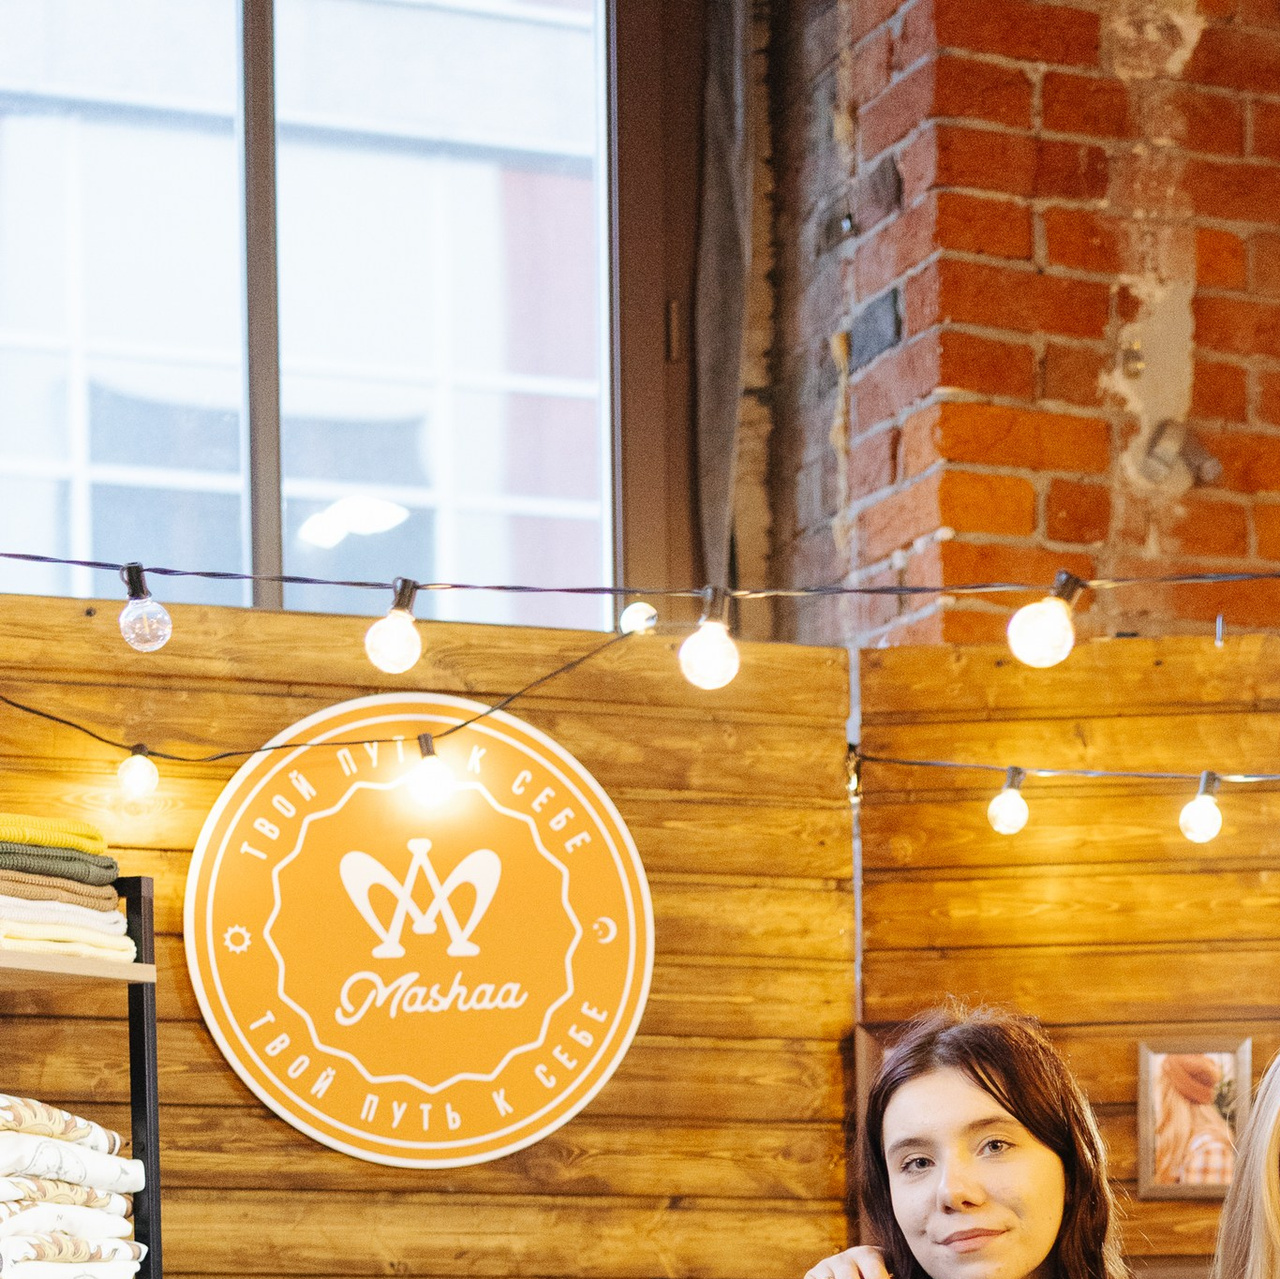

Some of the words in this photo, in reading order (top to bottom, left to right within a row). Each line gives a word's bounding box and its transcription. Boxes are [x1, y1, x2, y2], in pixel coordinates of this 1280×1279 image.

[239, 769, 317, 860] ТВОЙ
[336, 735, 406, 777] ПУТ
[467, 744, 487, 774] К
[511, 769, 592, 854] СЕБЕ
[334, 970, 529, 1027] Mashaa
[249, 1009, 337, 1099] ТВОЙ
[360, 1093, 462, 1132] ПУТЬ
[491, 1088, 515, 1118] К
[534, 1001, 609, 1089] СЕБЕ
